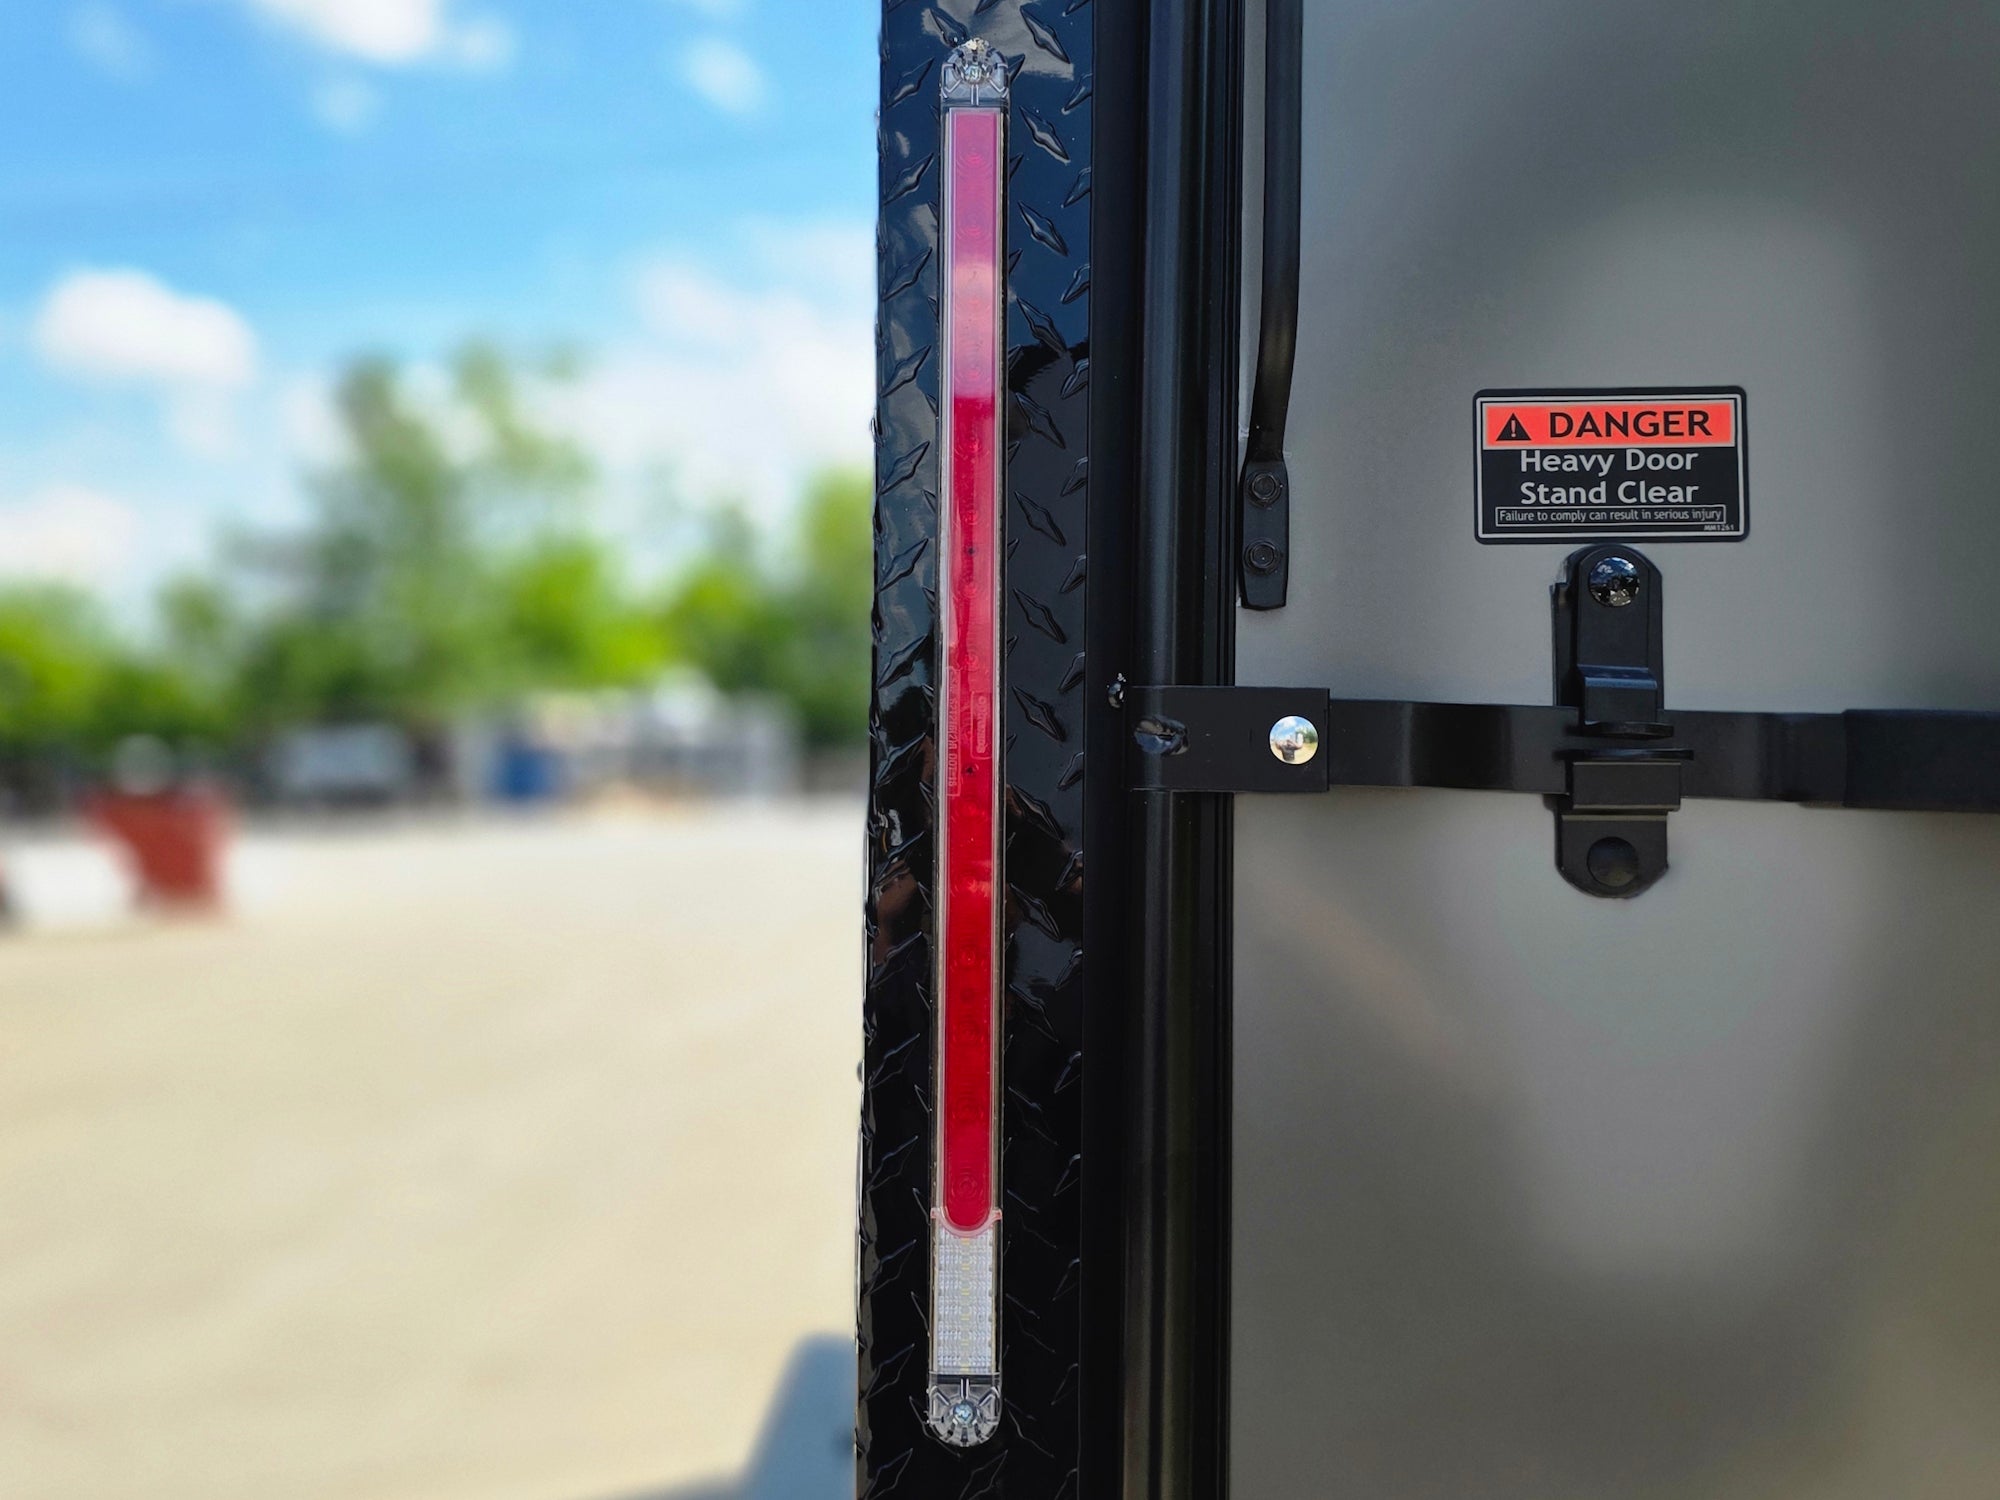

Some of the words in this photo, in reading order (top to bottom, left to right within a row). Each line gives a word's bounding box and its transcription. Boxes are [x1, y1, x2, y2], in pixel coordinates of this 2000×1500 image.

[1550, 410, 1713, 438] DANGER
[1520, 449, 1615, 477] Heavy
[1626, 448, 1699, 471] Door
[1520, 481, 1606, 505] Stand
[1617, 480, 1700, 504] Clear
[1500, 509, 1535, 521] Failure
[1537, 511, 1548, 521] to
[1550, 509, 1587, 523] comply
[1589, 511, 1607, 521] can
[1610, 508, 1639, 520] result
[1641, 508, 1652, 520] in
[1654, 508, 1690, 520] serious
[1692, 508, 1722, 521] injury
